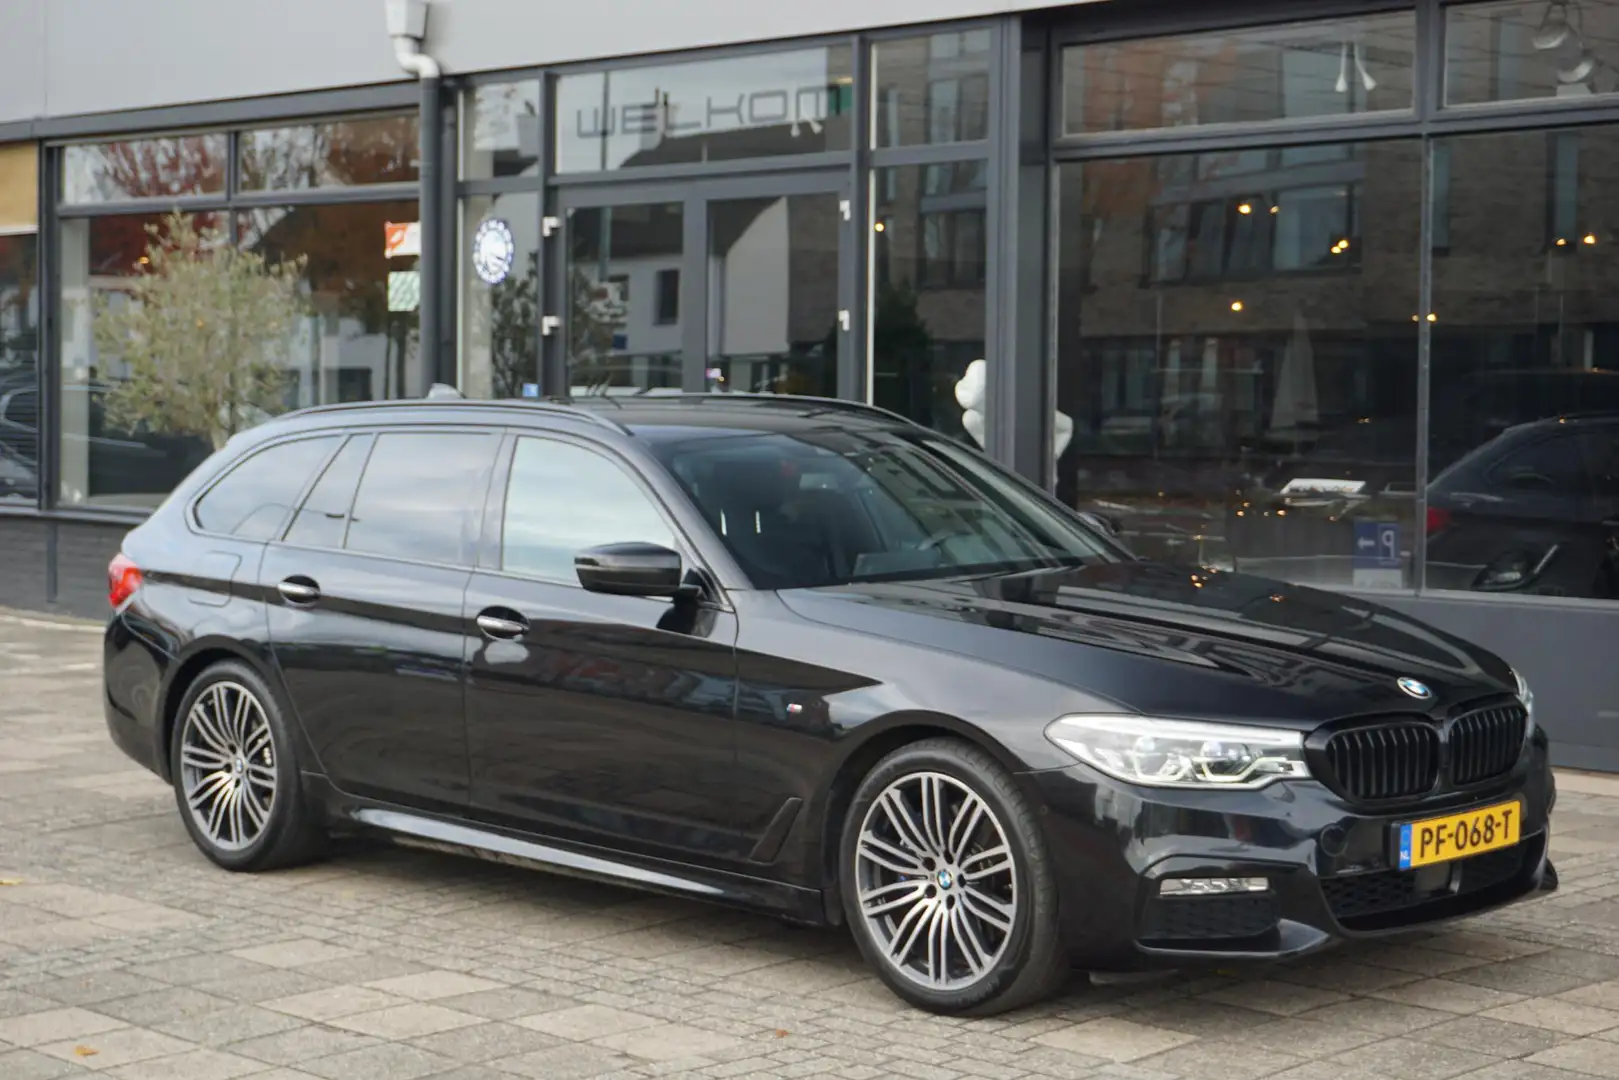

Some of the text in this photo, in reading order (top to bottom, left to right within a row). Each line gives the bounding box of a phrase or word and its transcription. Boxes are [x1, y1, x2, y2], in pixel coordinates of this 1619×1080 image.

[577, 84, 840, 138] WELKOM
[1400, 850, 1410, 860] NL
[1420, 809, 1512, 858] PF-068-T
